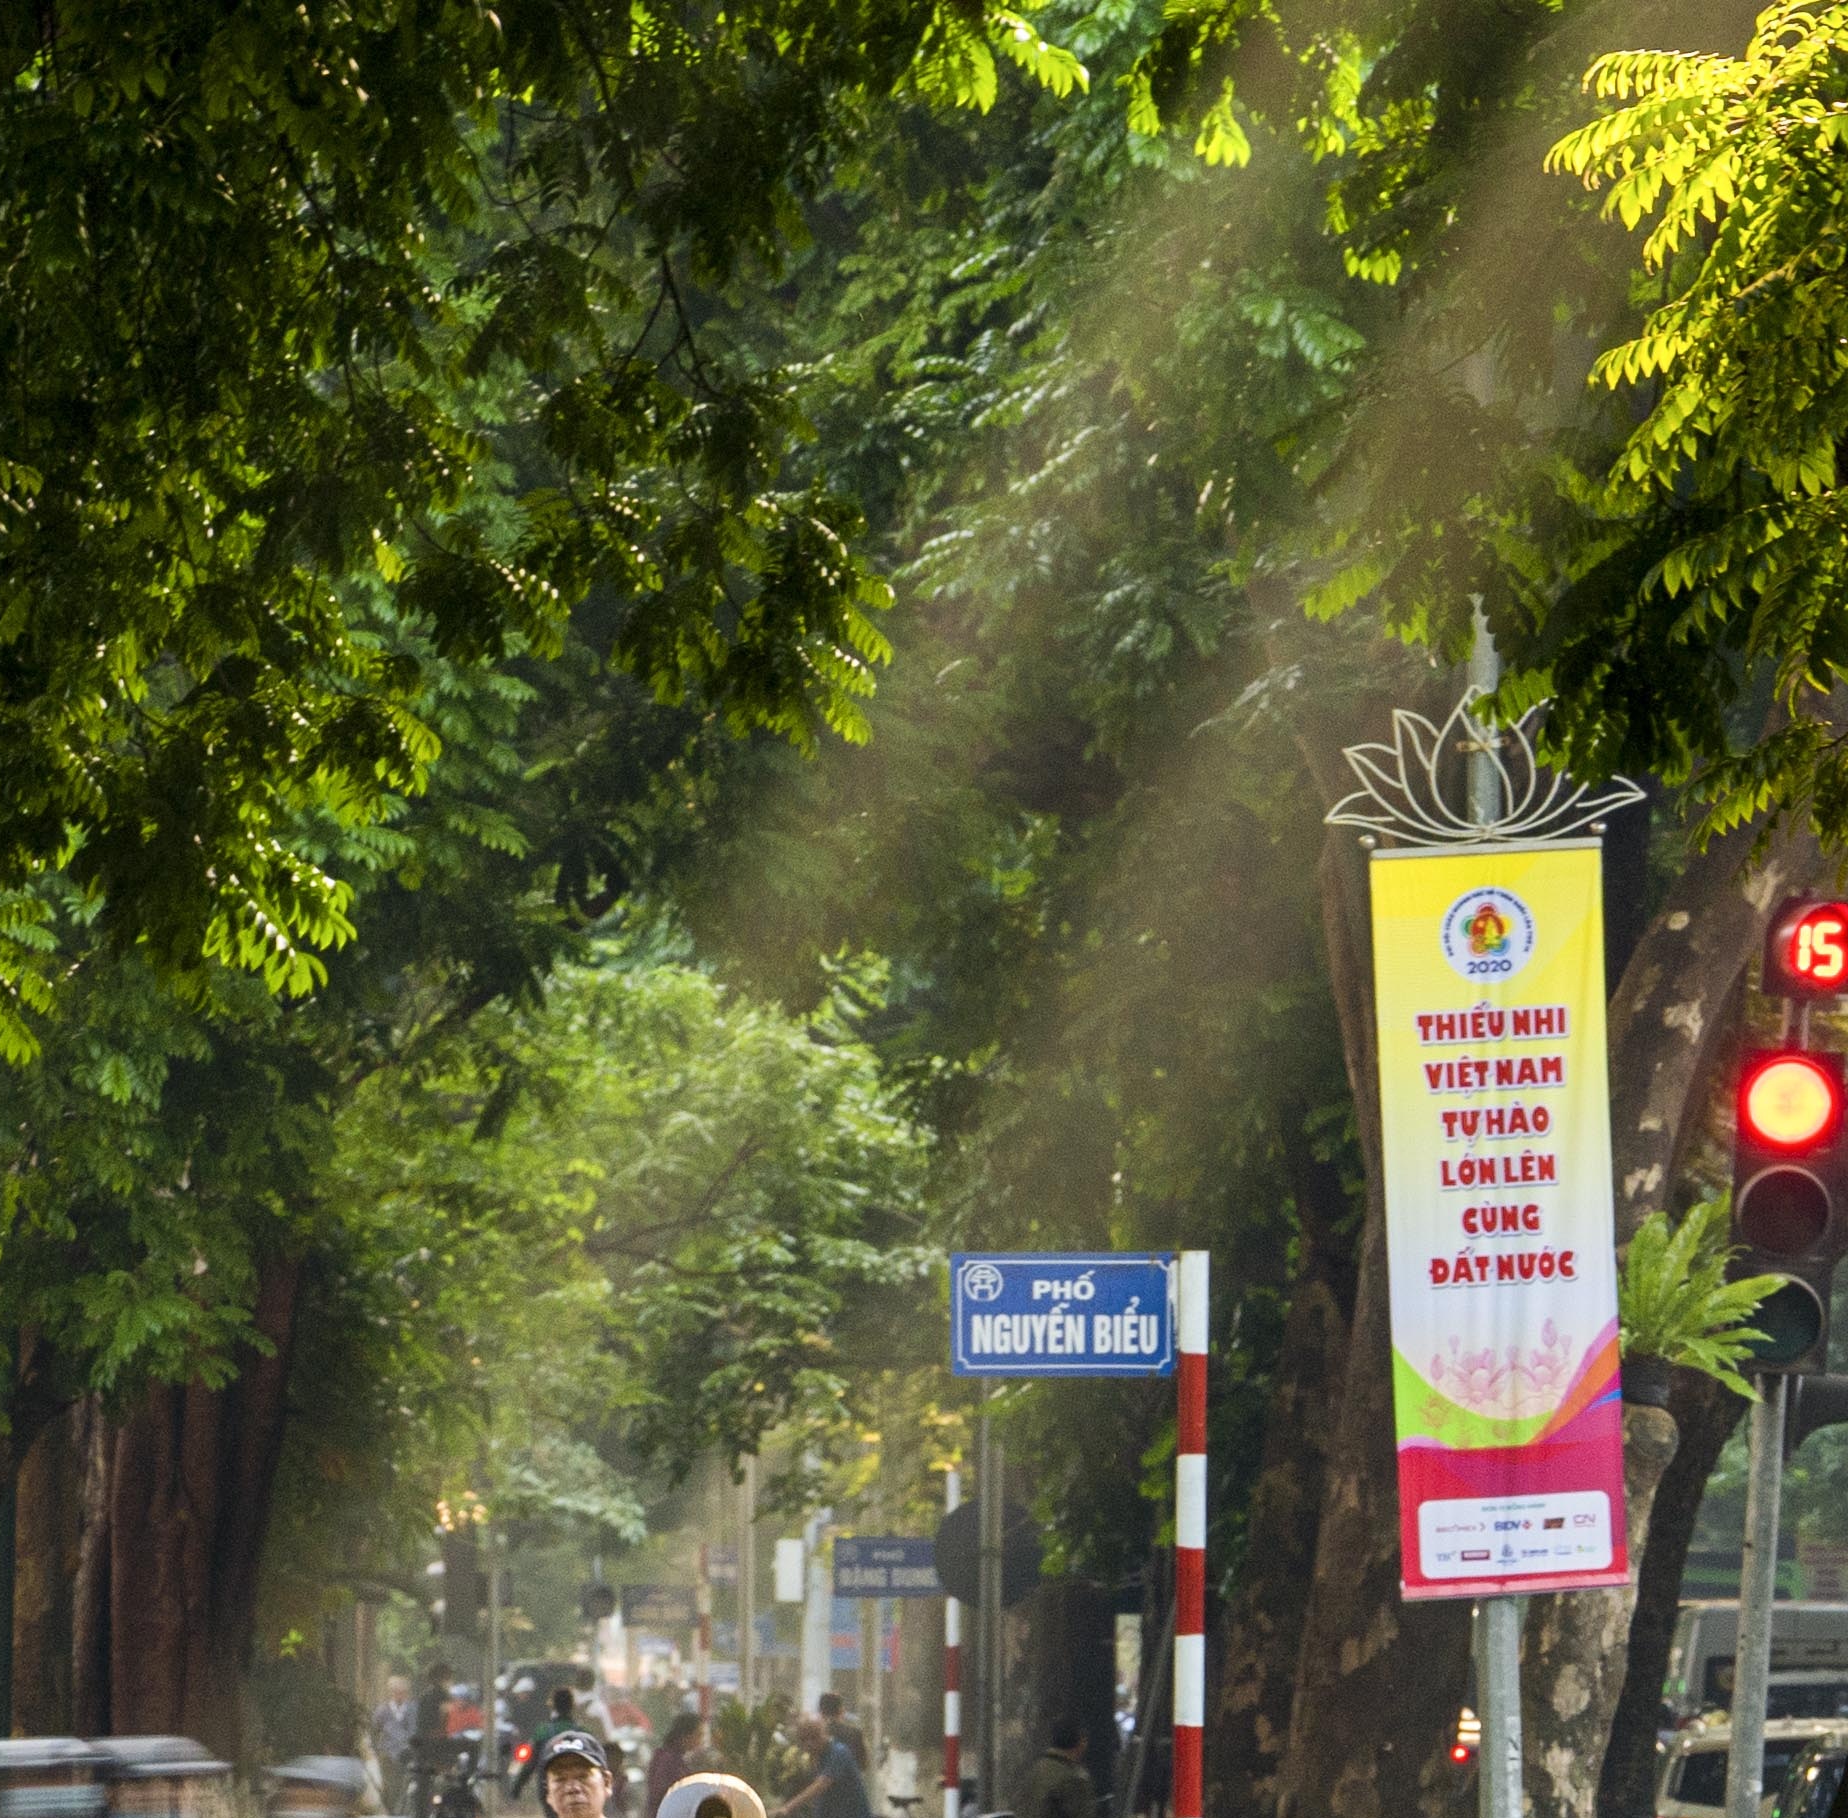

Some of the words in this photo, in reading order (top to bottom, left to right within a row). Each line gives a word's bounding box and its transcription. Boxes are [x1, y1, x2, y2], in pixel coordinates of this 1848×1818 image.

[1467, 959, 1512, 974] 2020
[1797, 921, 1843, 977] 15
[1418, 1001, 1506, 1042] THIẾU
[1512, 1007, 1566, 1037] NHI
[1424, 1055, 1489, 1093] VIỆT
[1495, 1055, 1563, 1086] NAM
[1442, 1109, 1481, 1143] TỰ
[1485, 1101, 1550, 1135] HÀO
[1440, 1152, 1497, 1187] LỚN
[1503, 1149, 1556, 1183] LÊN
[1462, 1200, 1541, 1235] CÙNG
[1429, 1246, 1490, 1285] ĐẤT
[1496, 1246, 1576, 1281] NƯỚC
[1031, 1269, 1096, 1301] PHỐ
[971, 1302, 1086, 1355] NGUYỄN
[1093, 1296, 1159, 1355] BIỂU
